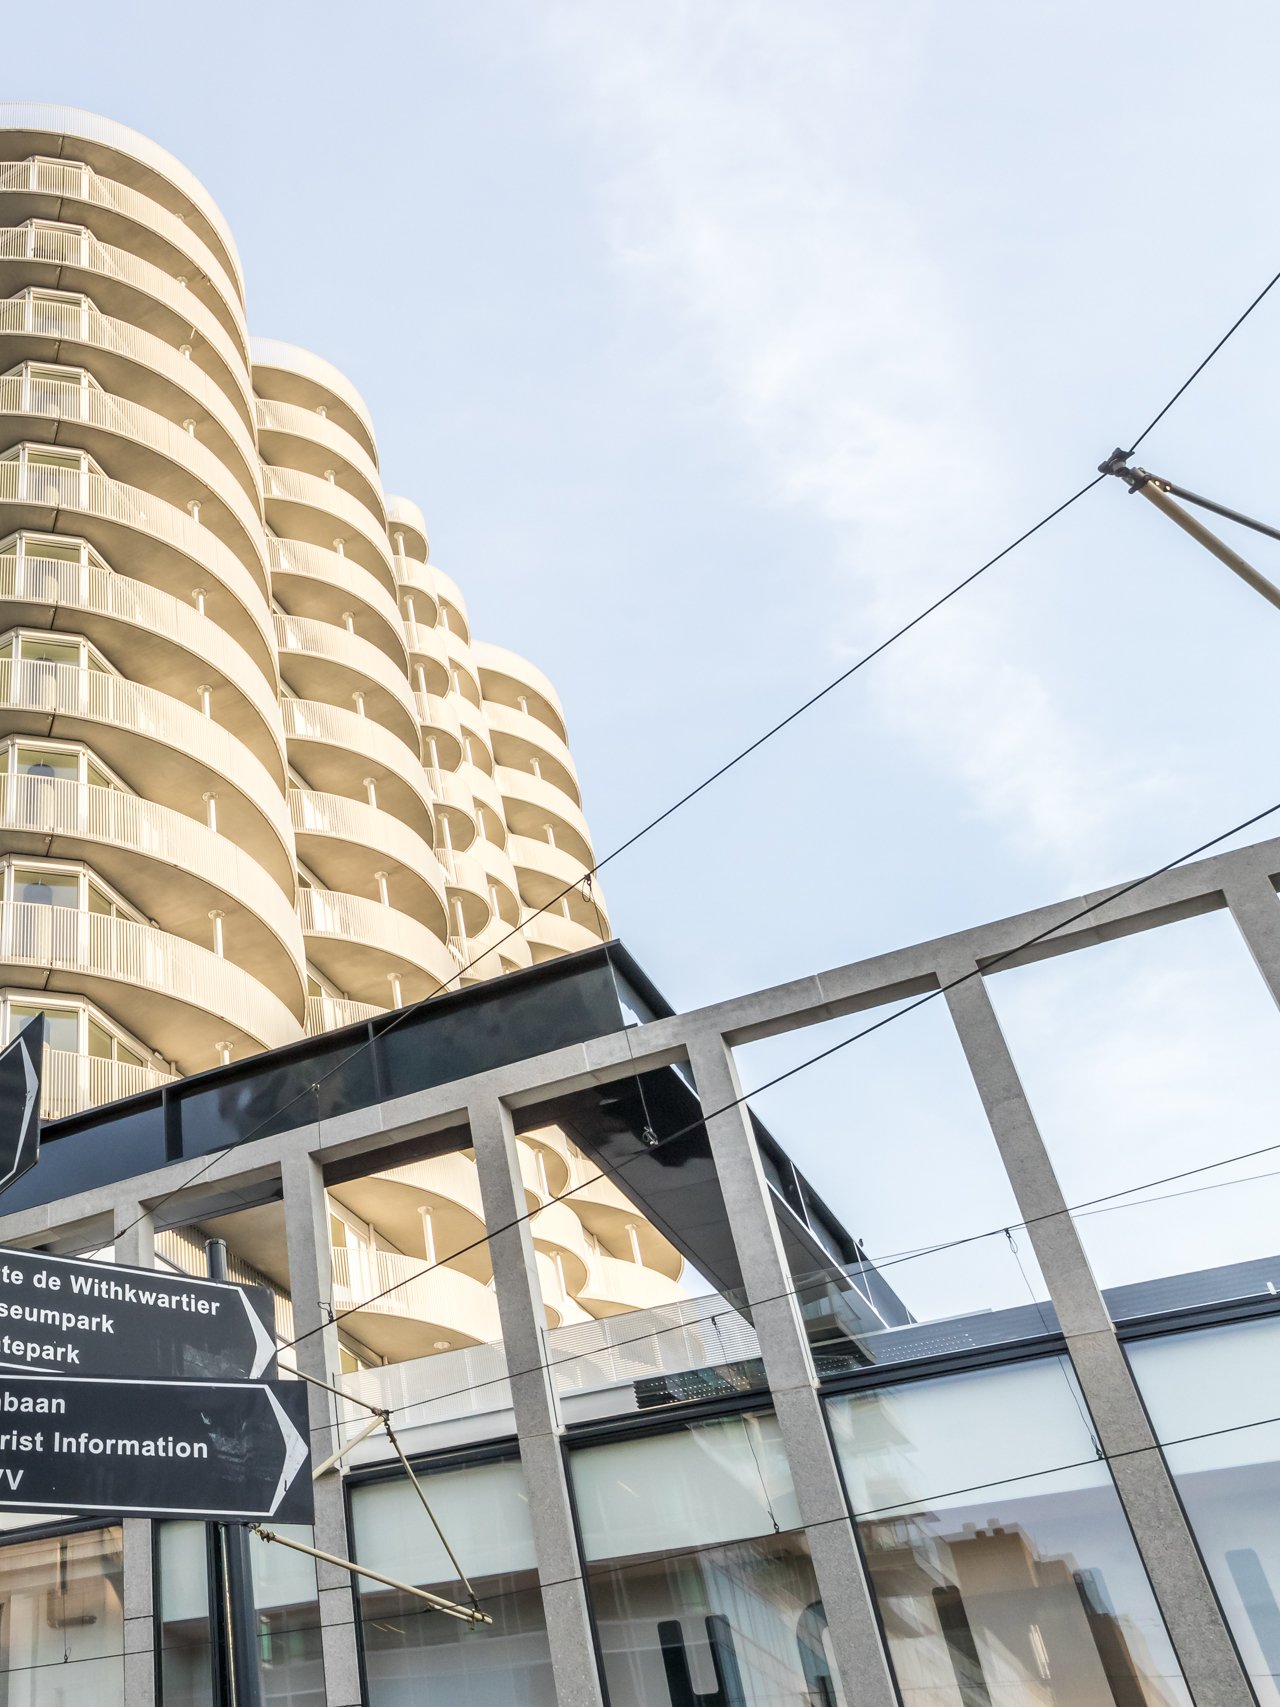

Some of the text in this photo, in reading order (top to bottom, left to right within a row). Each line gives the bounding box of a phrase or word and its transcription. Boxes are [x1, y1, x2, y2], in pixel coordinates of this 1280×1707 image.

[32, 1270, 62, 1291] de
[69, 1274, 220, 1316] Withkwartier
[53, 1431, 208, 1459] Information
